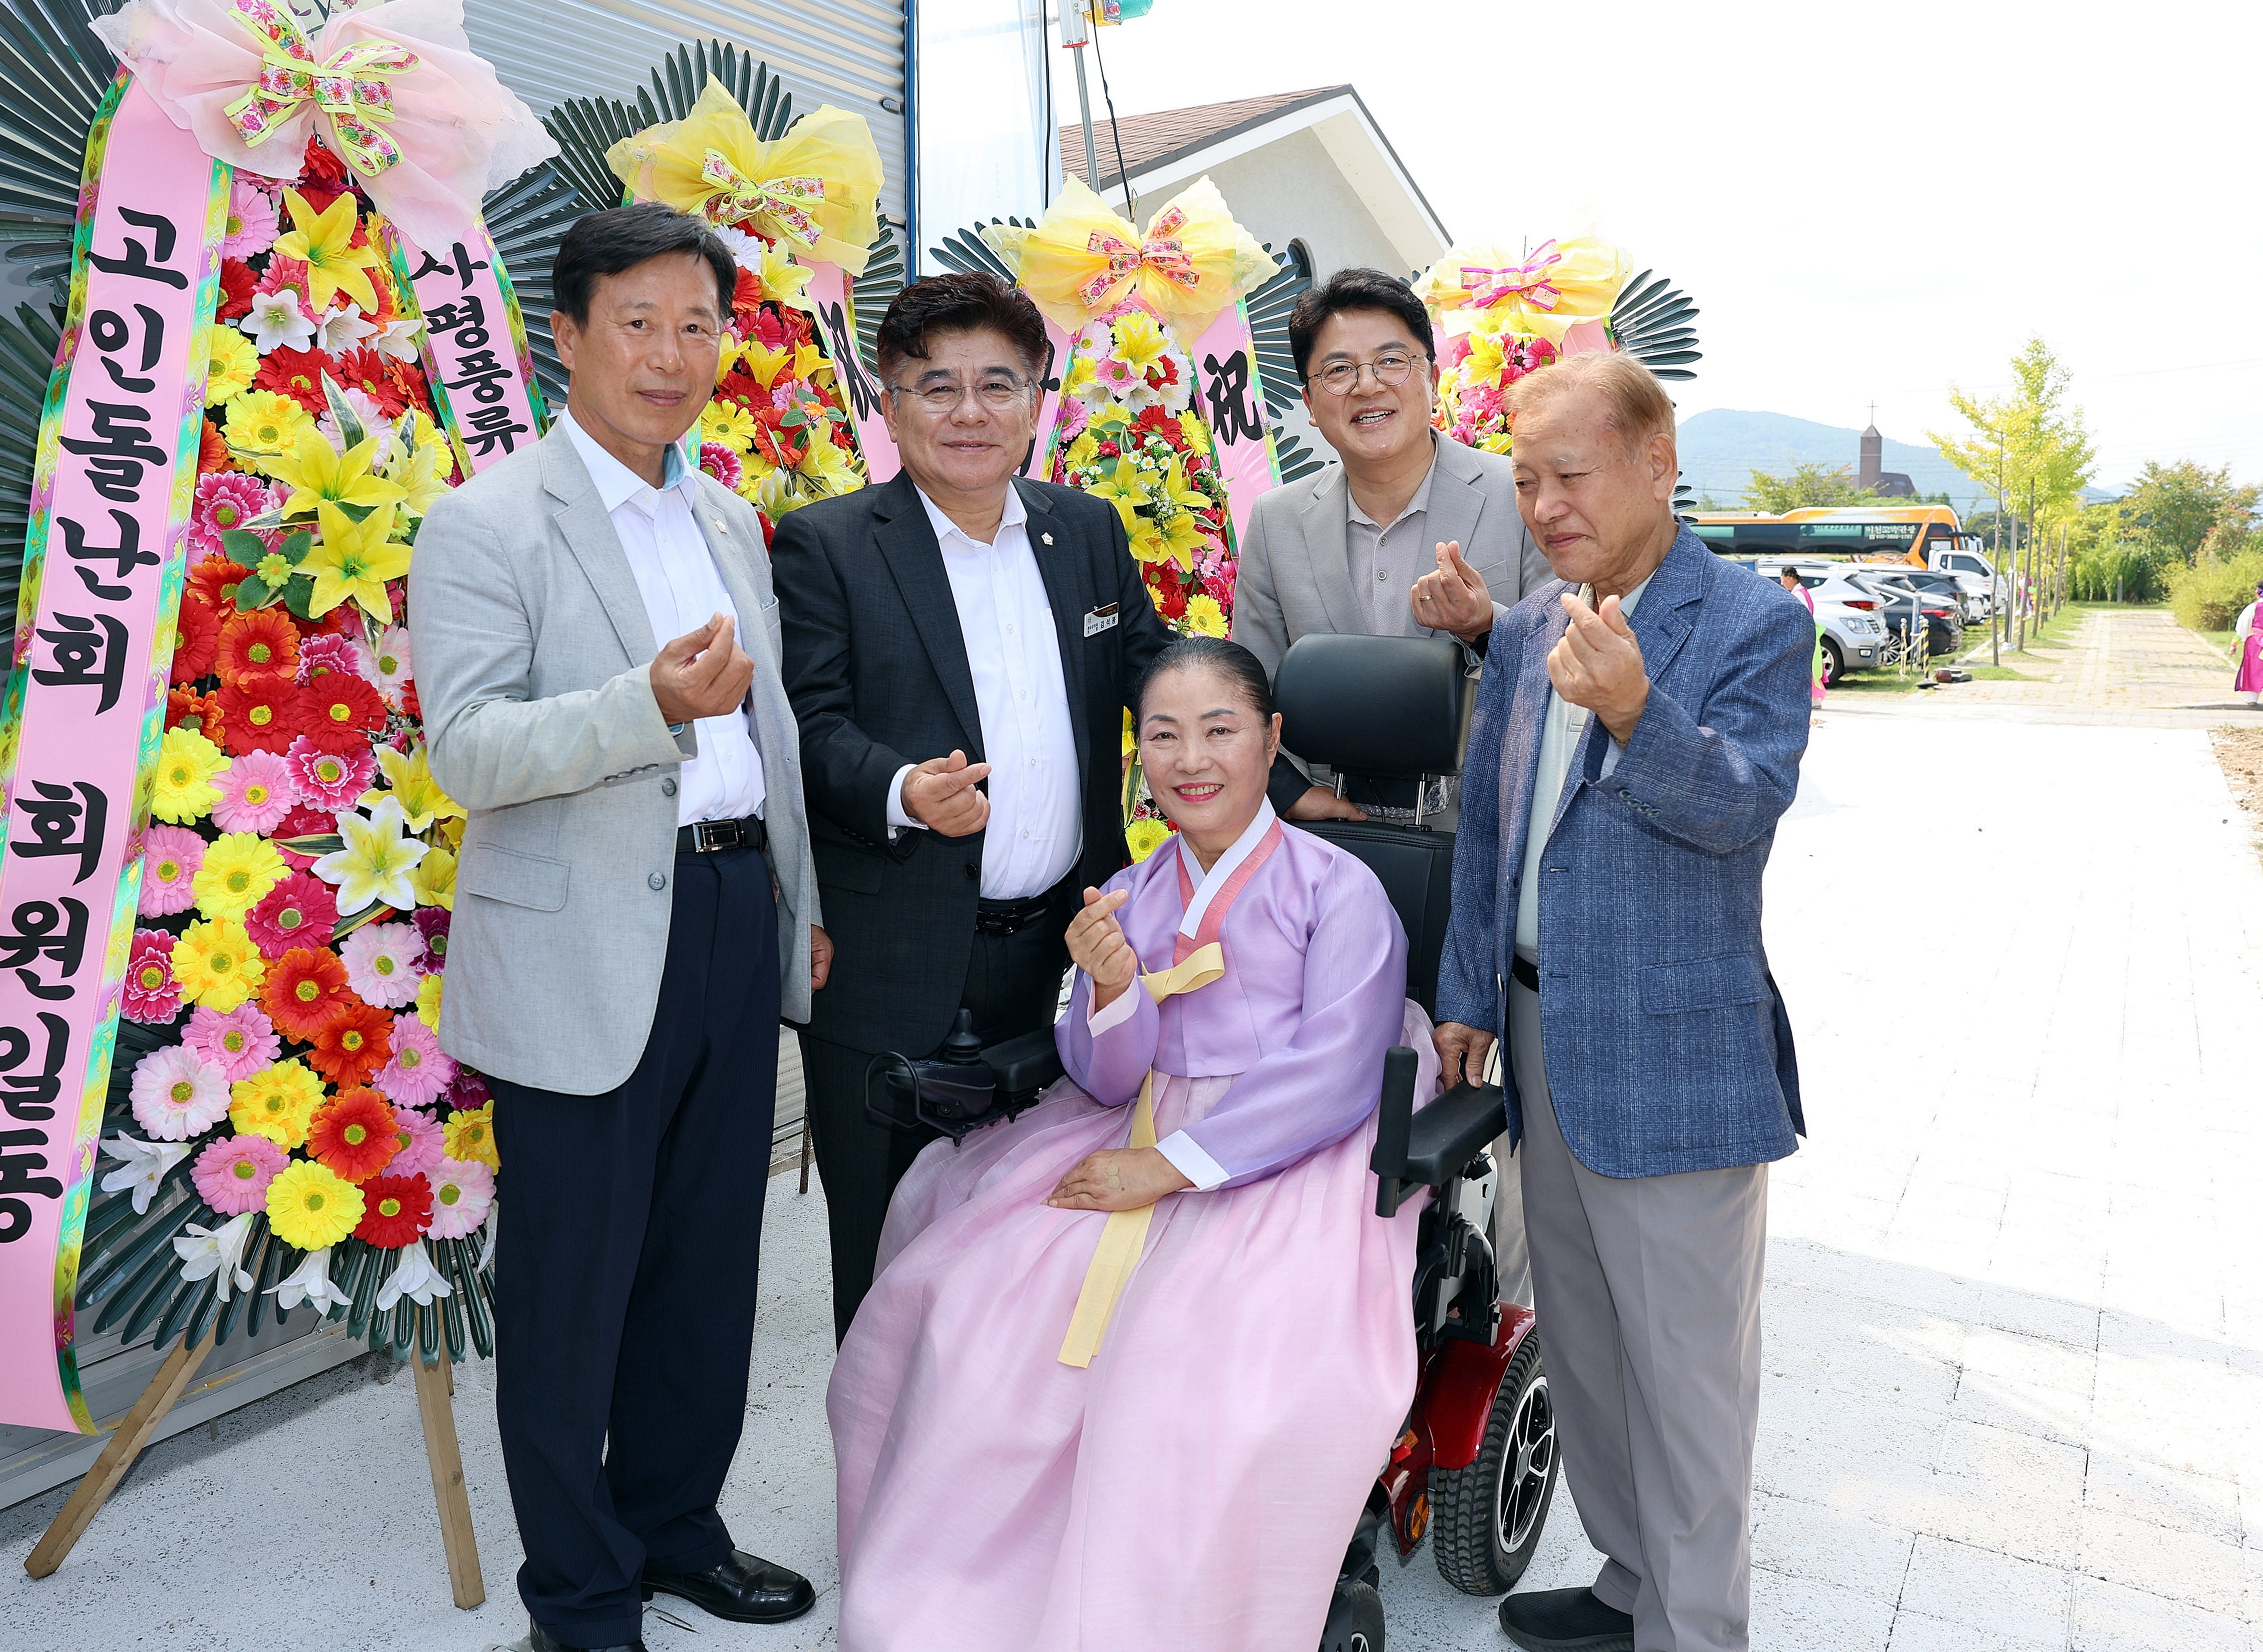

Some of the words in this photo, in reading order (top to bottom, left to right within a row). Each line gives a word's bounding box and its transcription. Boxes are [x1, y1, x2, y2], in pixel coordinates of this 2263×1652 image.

[406, 241, 528, 457] 사평풍류
[1203, 350, 1265, 446] 祝
[0, 779, 108, 1243] 회원일동
